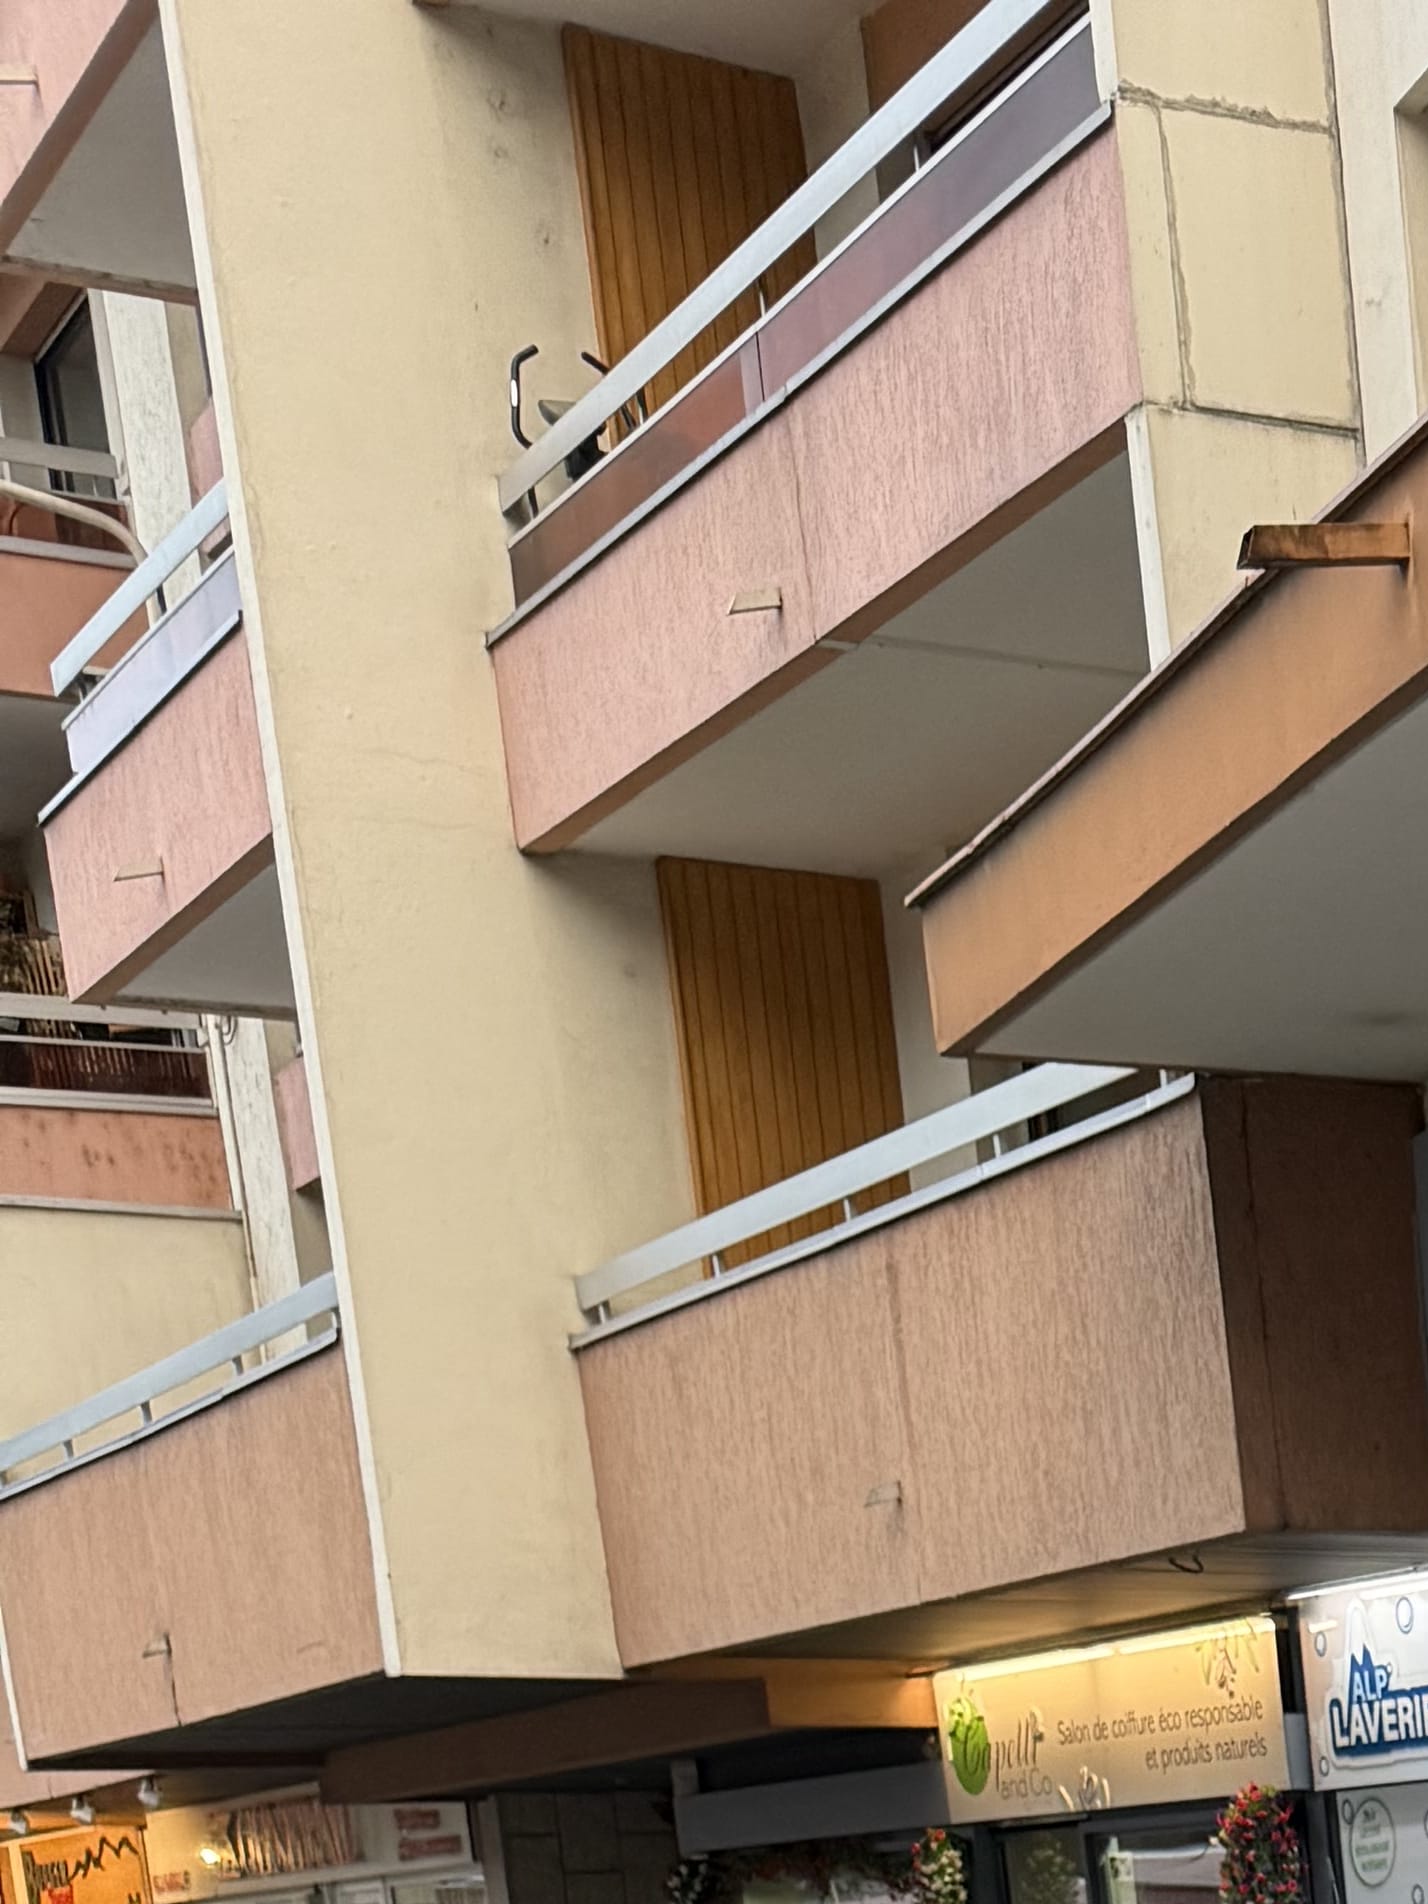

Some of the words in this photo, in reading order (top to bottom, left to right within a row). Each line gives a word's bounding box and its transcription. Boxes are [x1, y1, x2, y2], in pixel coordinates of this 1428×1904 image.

[1057, 1720, 1090, 1746] Salon
[1093, 1718, 1110, 1741] de
[1112, 1710, 1155, 1738] coiffure
[1159, 1707, 1182, 1732] éco
[1184, 1698, 1264, 1735] responsable
[1145, 1750, 1159, 1770] et
[1160, 1742, 1213, 1776] produits
[1215, 1732, 1268, 1763] naturels
